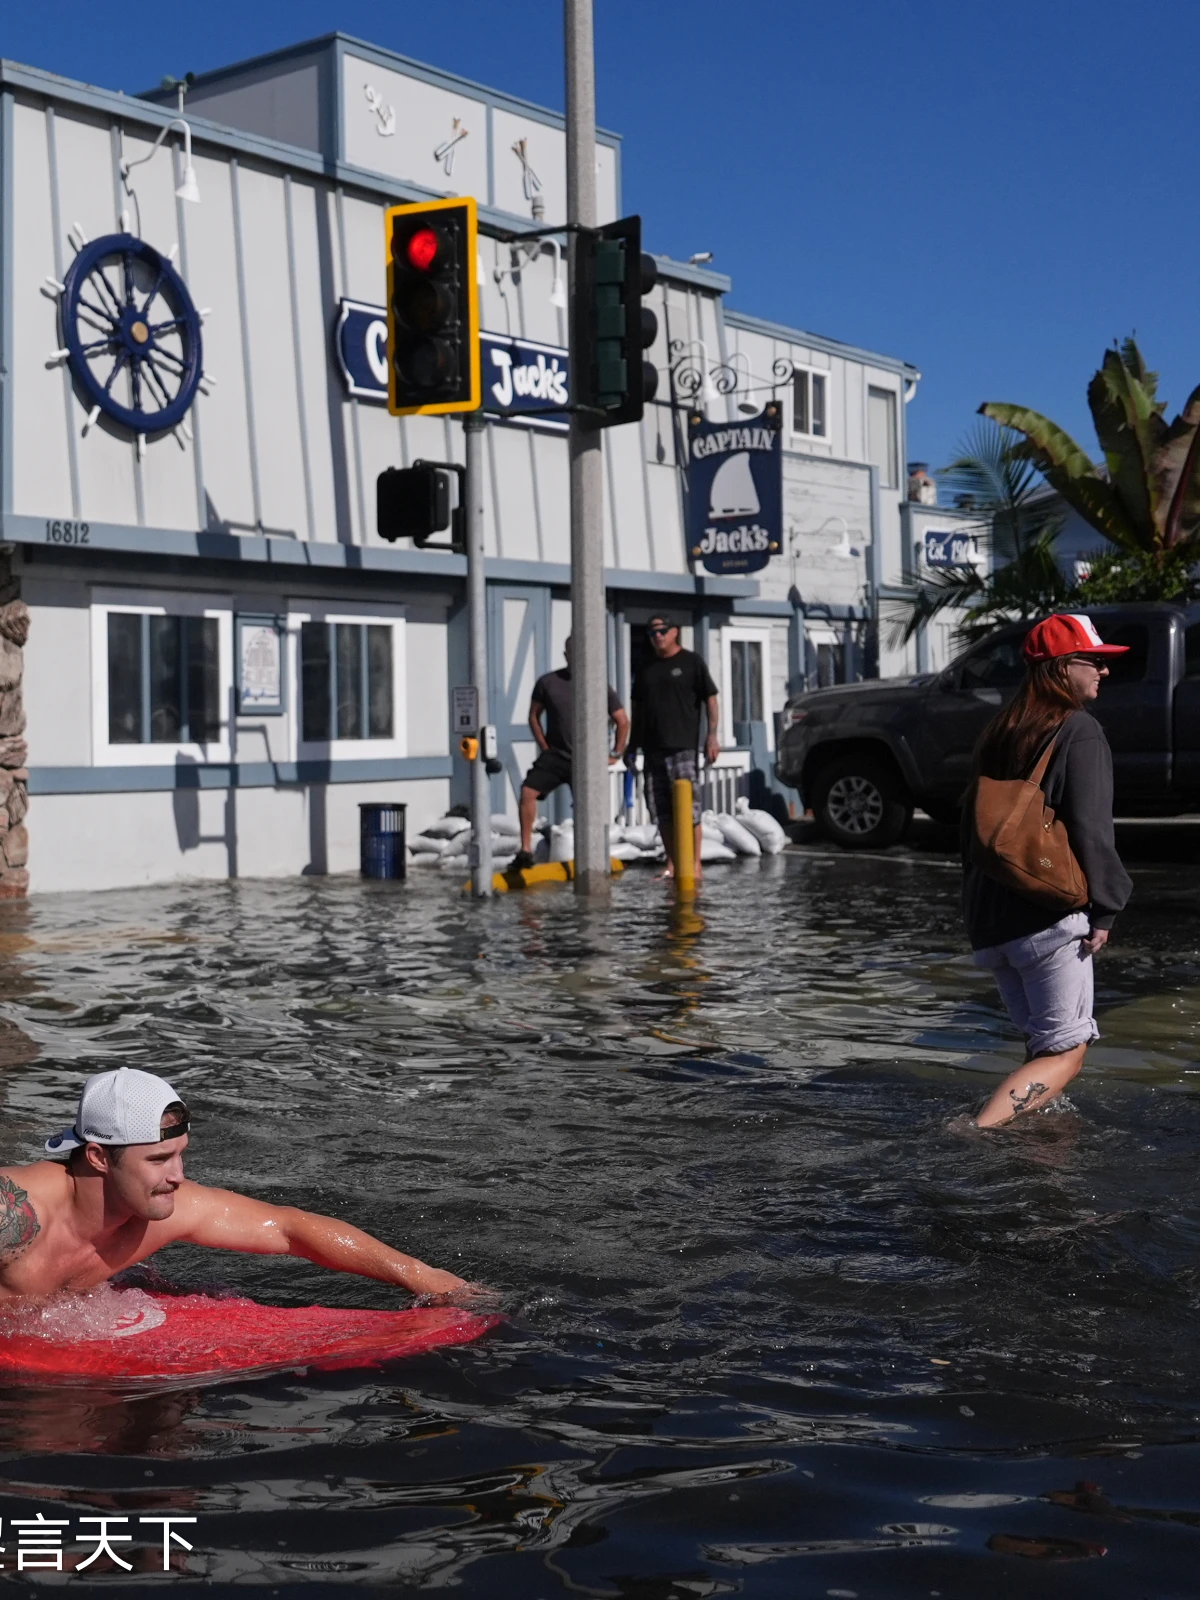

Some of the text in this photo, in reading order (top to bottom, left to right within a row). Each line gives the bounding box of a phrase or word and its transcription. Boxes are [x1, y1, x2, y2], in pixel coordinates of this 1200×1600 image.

[490, 348, 568, 406] Jack's
[692, 427, 776, 459] CAPTAIN
[46, 519, 90, 544] 16812
[701, 524, 769, 554] Jack's
